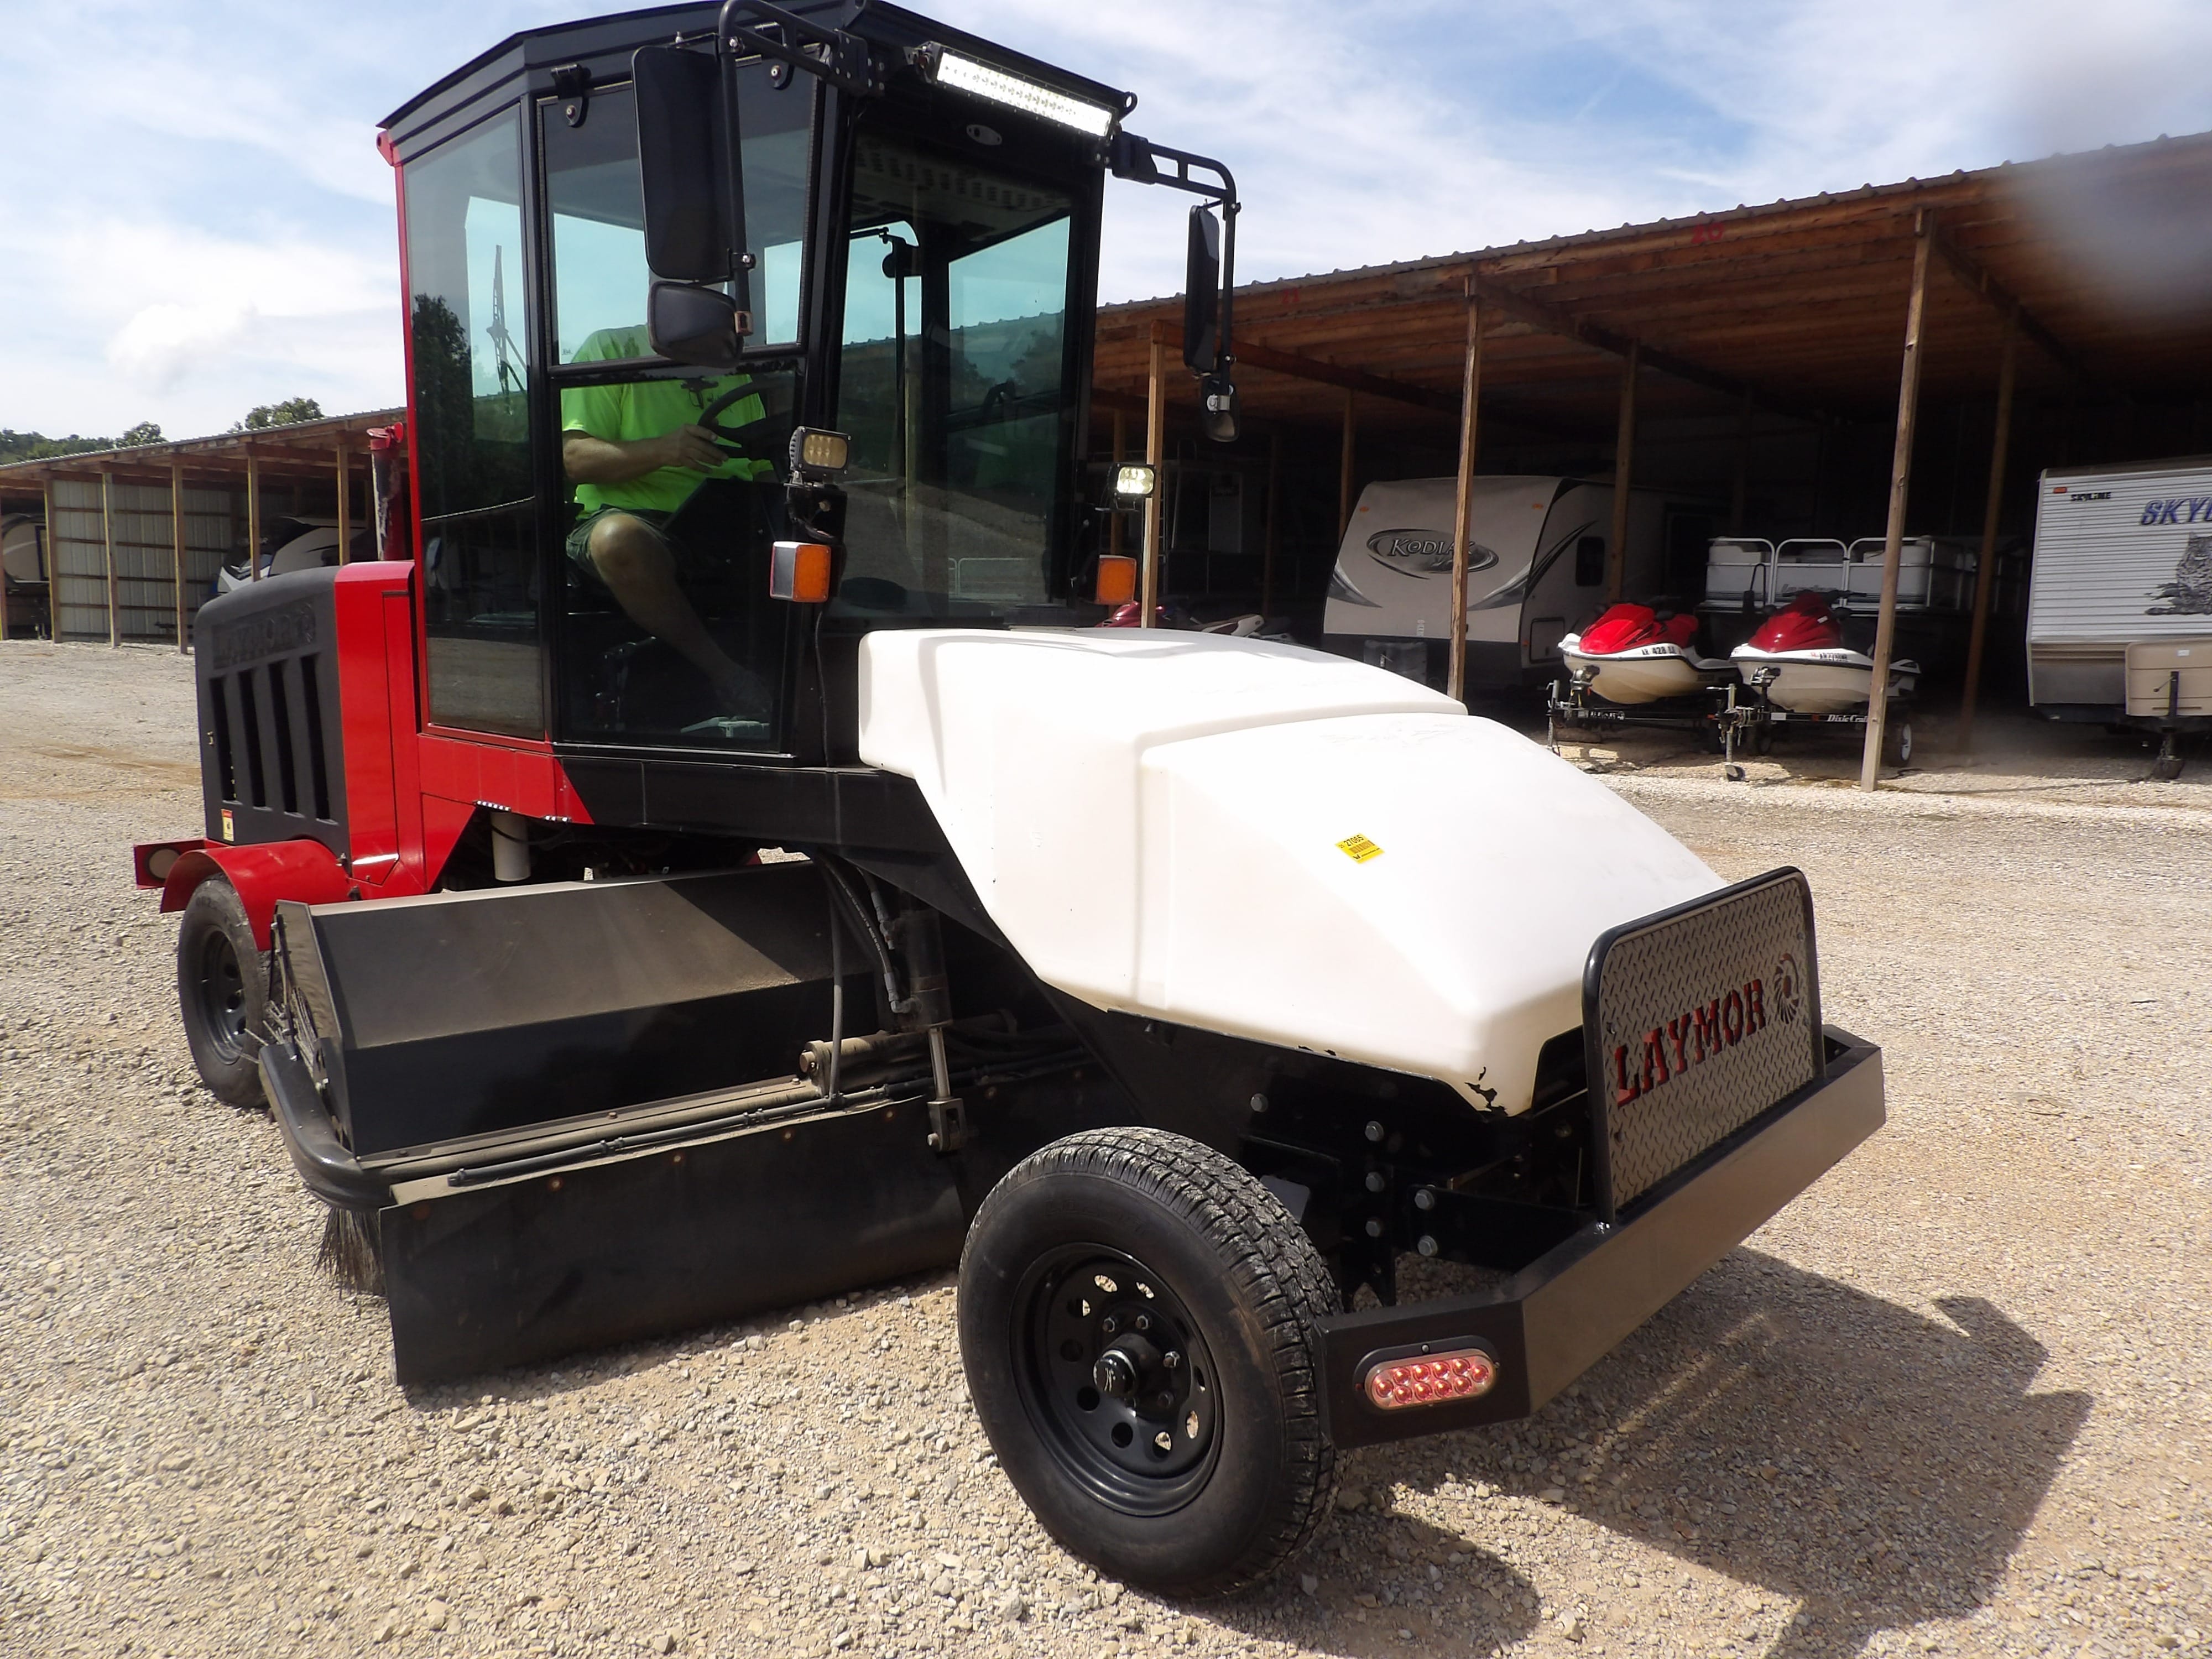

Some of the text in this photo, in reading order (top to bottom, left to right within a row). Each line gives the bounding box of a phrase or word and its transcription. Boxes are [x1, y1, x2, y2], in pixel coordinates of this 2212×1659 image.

[1691, 223, 1724, 244] 20
[1652, 646, 1666, 654] 428
[1343, 834, 1364, 846] 27065
[1614, 978, 1766, 1107] LAYMOR
